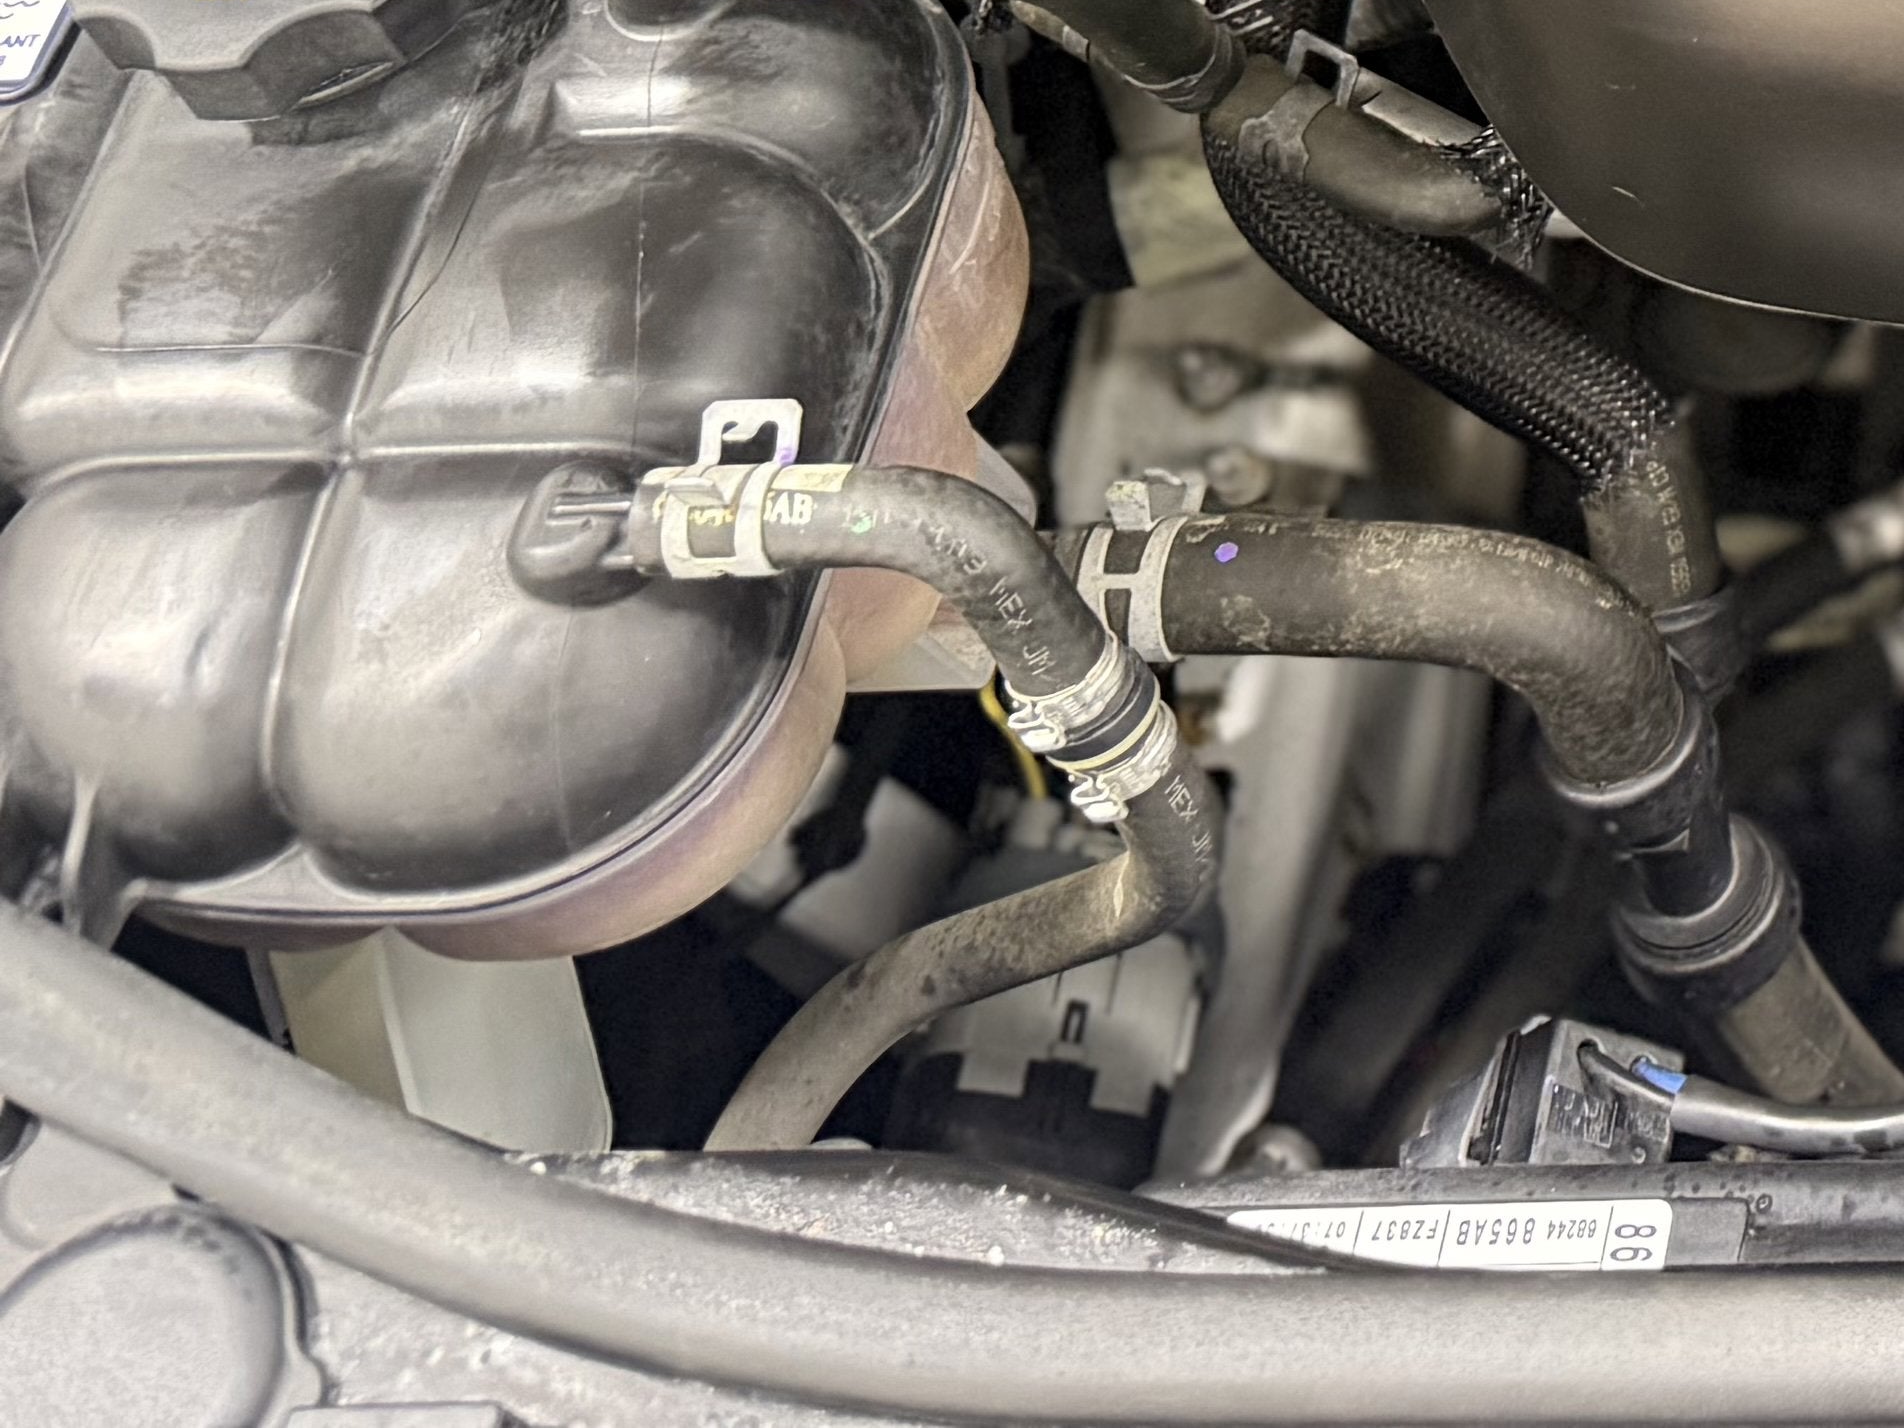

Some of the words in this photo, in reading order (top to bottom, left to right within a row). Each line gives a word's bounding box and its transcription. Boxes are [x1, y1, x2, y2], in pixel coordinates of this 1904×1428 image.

[1163, 774, 1200, 824] MEX
[1370, 1218, 1440, 1242] FZ837
[1456, 1216, 1537, 1246] 865AB
